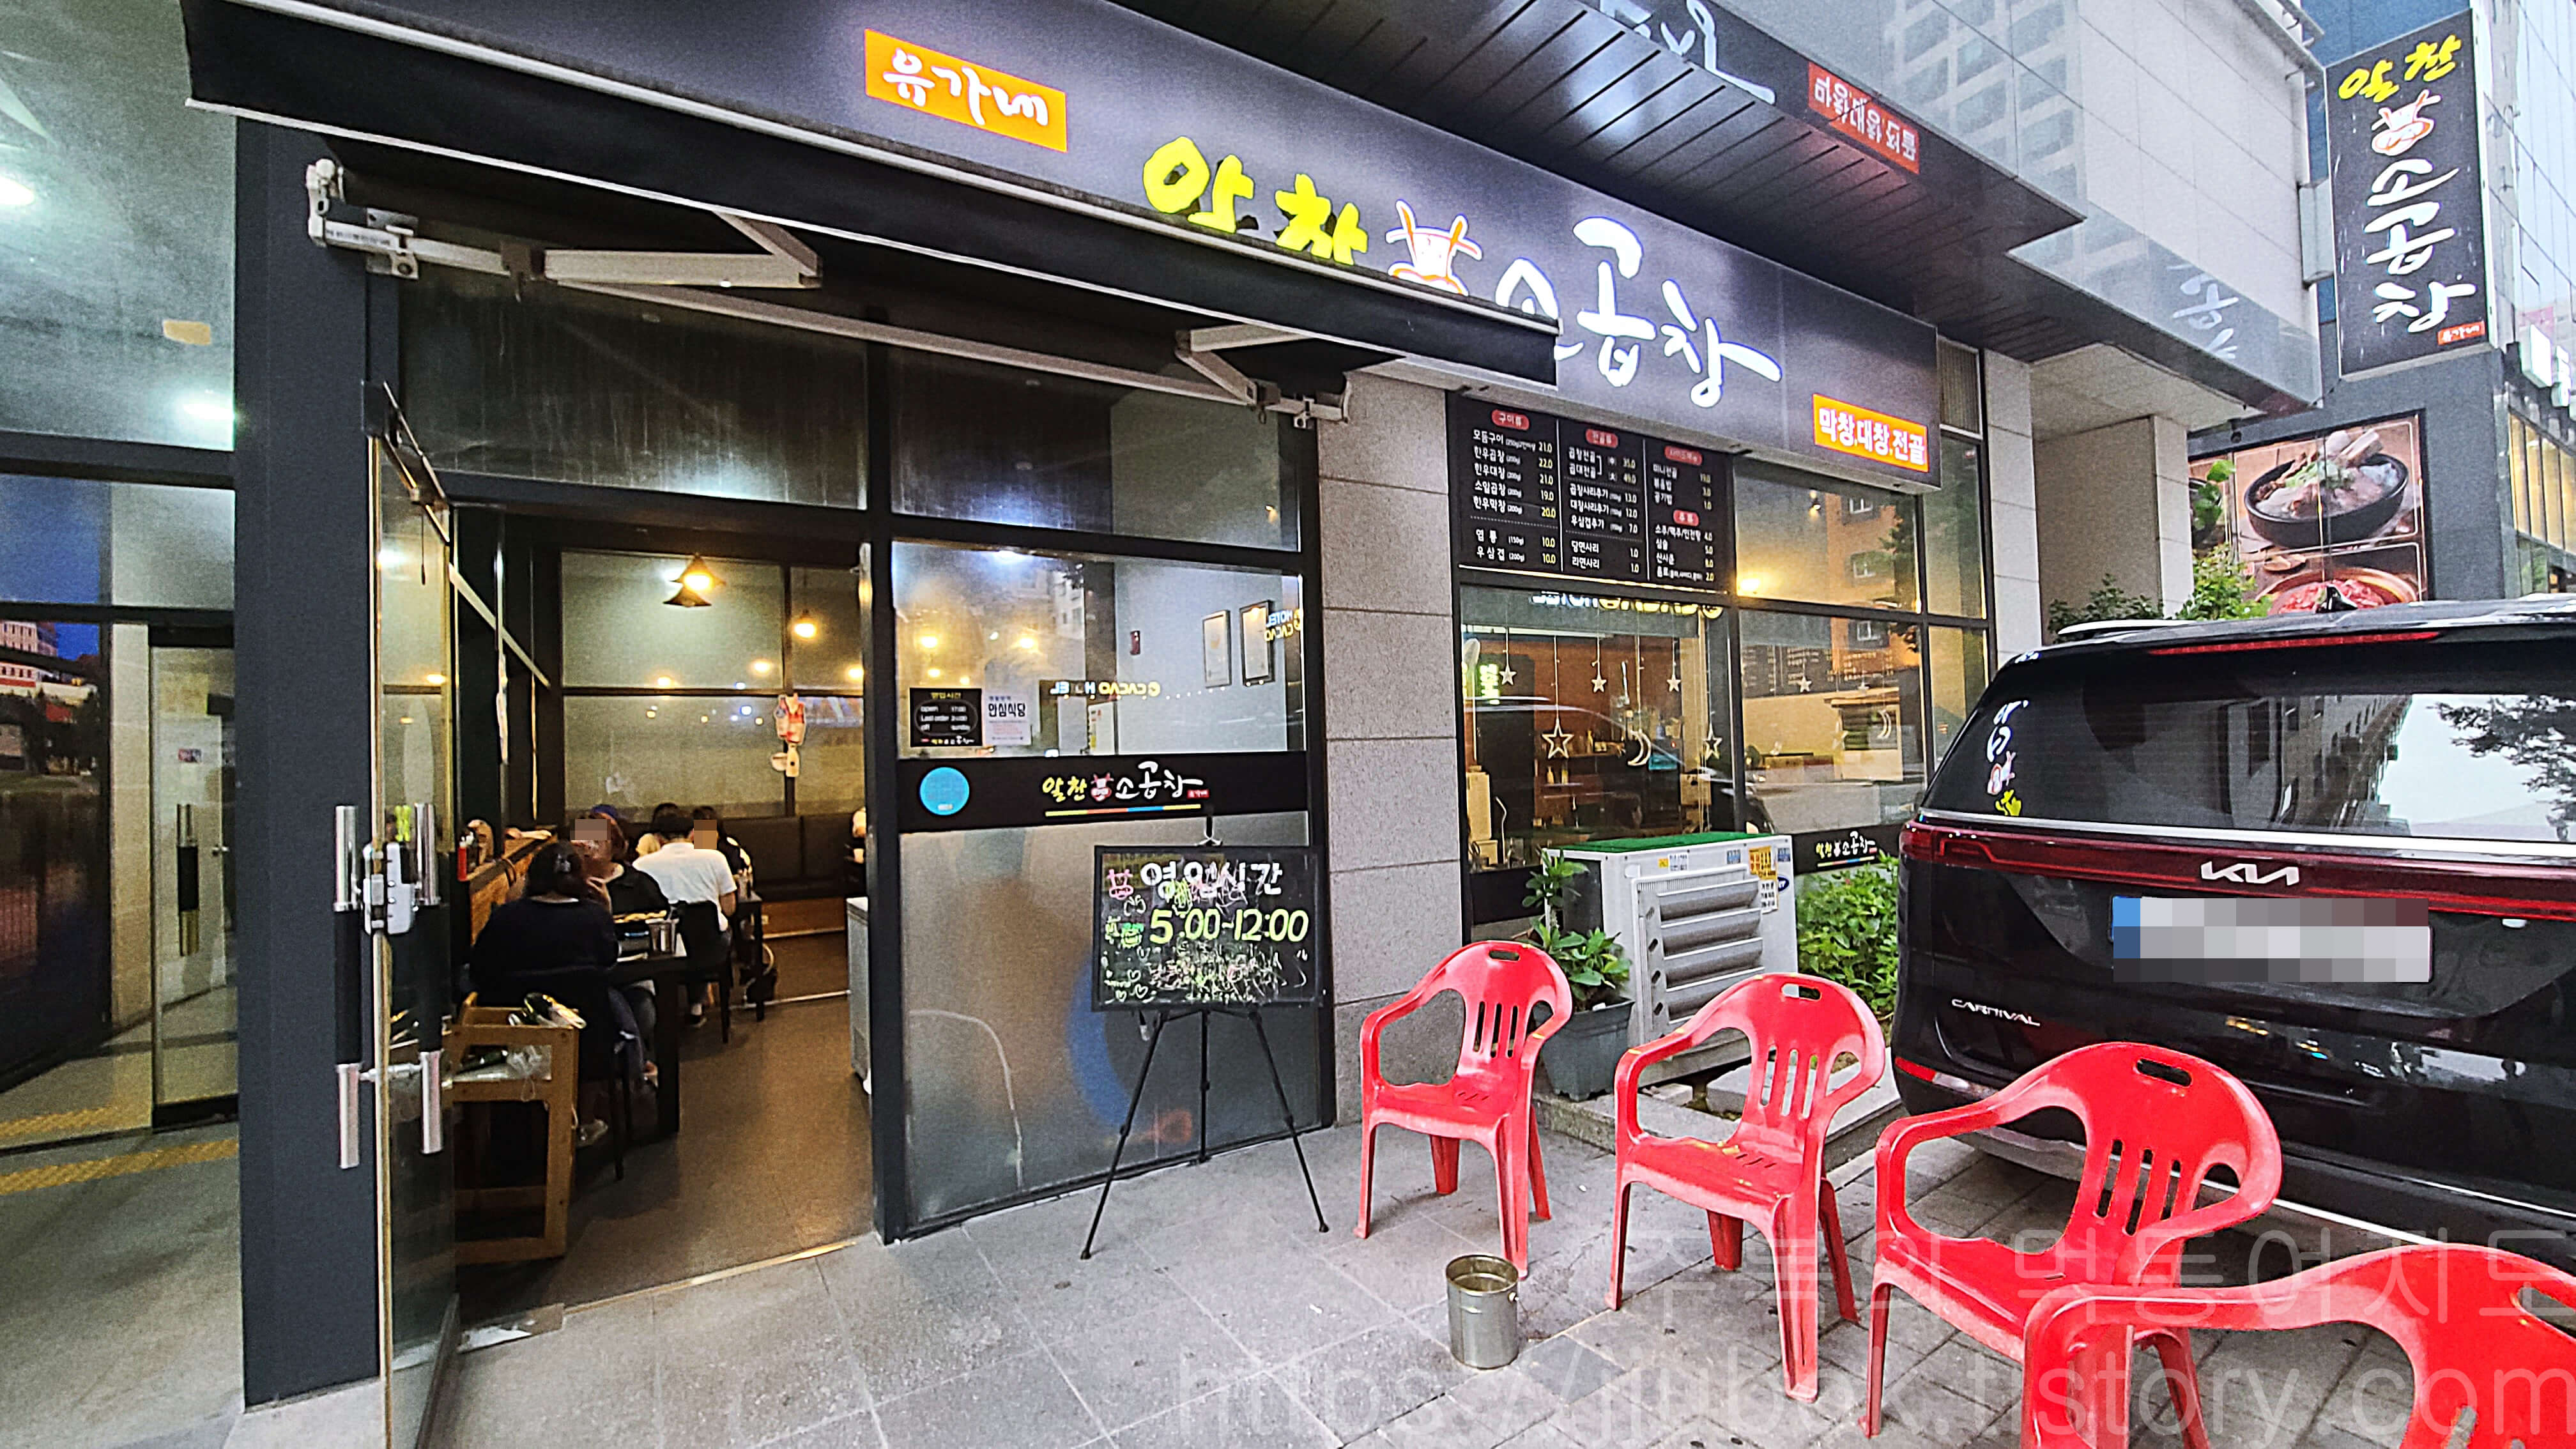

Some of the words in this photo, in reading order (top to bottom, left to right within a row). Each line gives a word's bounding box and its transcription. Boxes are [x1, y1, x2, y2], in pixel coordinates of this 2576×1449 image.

[2338, 33, 2462, 104] 알찬
[882, 47, 1049, 125] 유가네
[2363, 157, 2477, 333] 소곱창
[1472, 429, 1504, 445] 모둠구이
[1538, 441, 1553, 453] 21.0
[1473, 446, 1505, 463] 한우곱창
[1538, 457, 1553, 468] 22.0
[1474, 463, 1505, 480] 한우대창
[1540, 473, 1554, 486] 21.0
[1540, 490, 1554, 502] 19.0
[1625, 493, 1637, 504] 13.0
[1473, 495, 1506, 514] 한우막창
[1541, 507, 1556, 519] 20.0
[1625, 508, 1638, 519] 12.0
[1629, 523, 1638, 534] 7.0
[1542, 536, 1556, 548] 10.0
[1570, 539, 1600, 555] 당면사리
[1630, 548, 1639, 558] 1.0
[1542, 553, 1556, 564] 10.0
[1572, 556, 1600, 569] 라면사리
[1630, 562, 1639, 574] 1.0
[988, 702, 1027, 719] 안심식당
[1041, 775, 1088, 803] 알찬
[1114, 760, 1204, 800] 소곱창
[1950, 997, 2042, 1028] CARNIVAL
